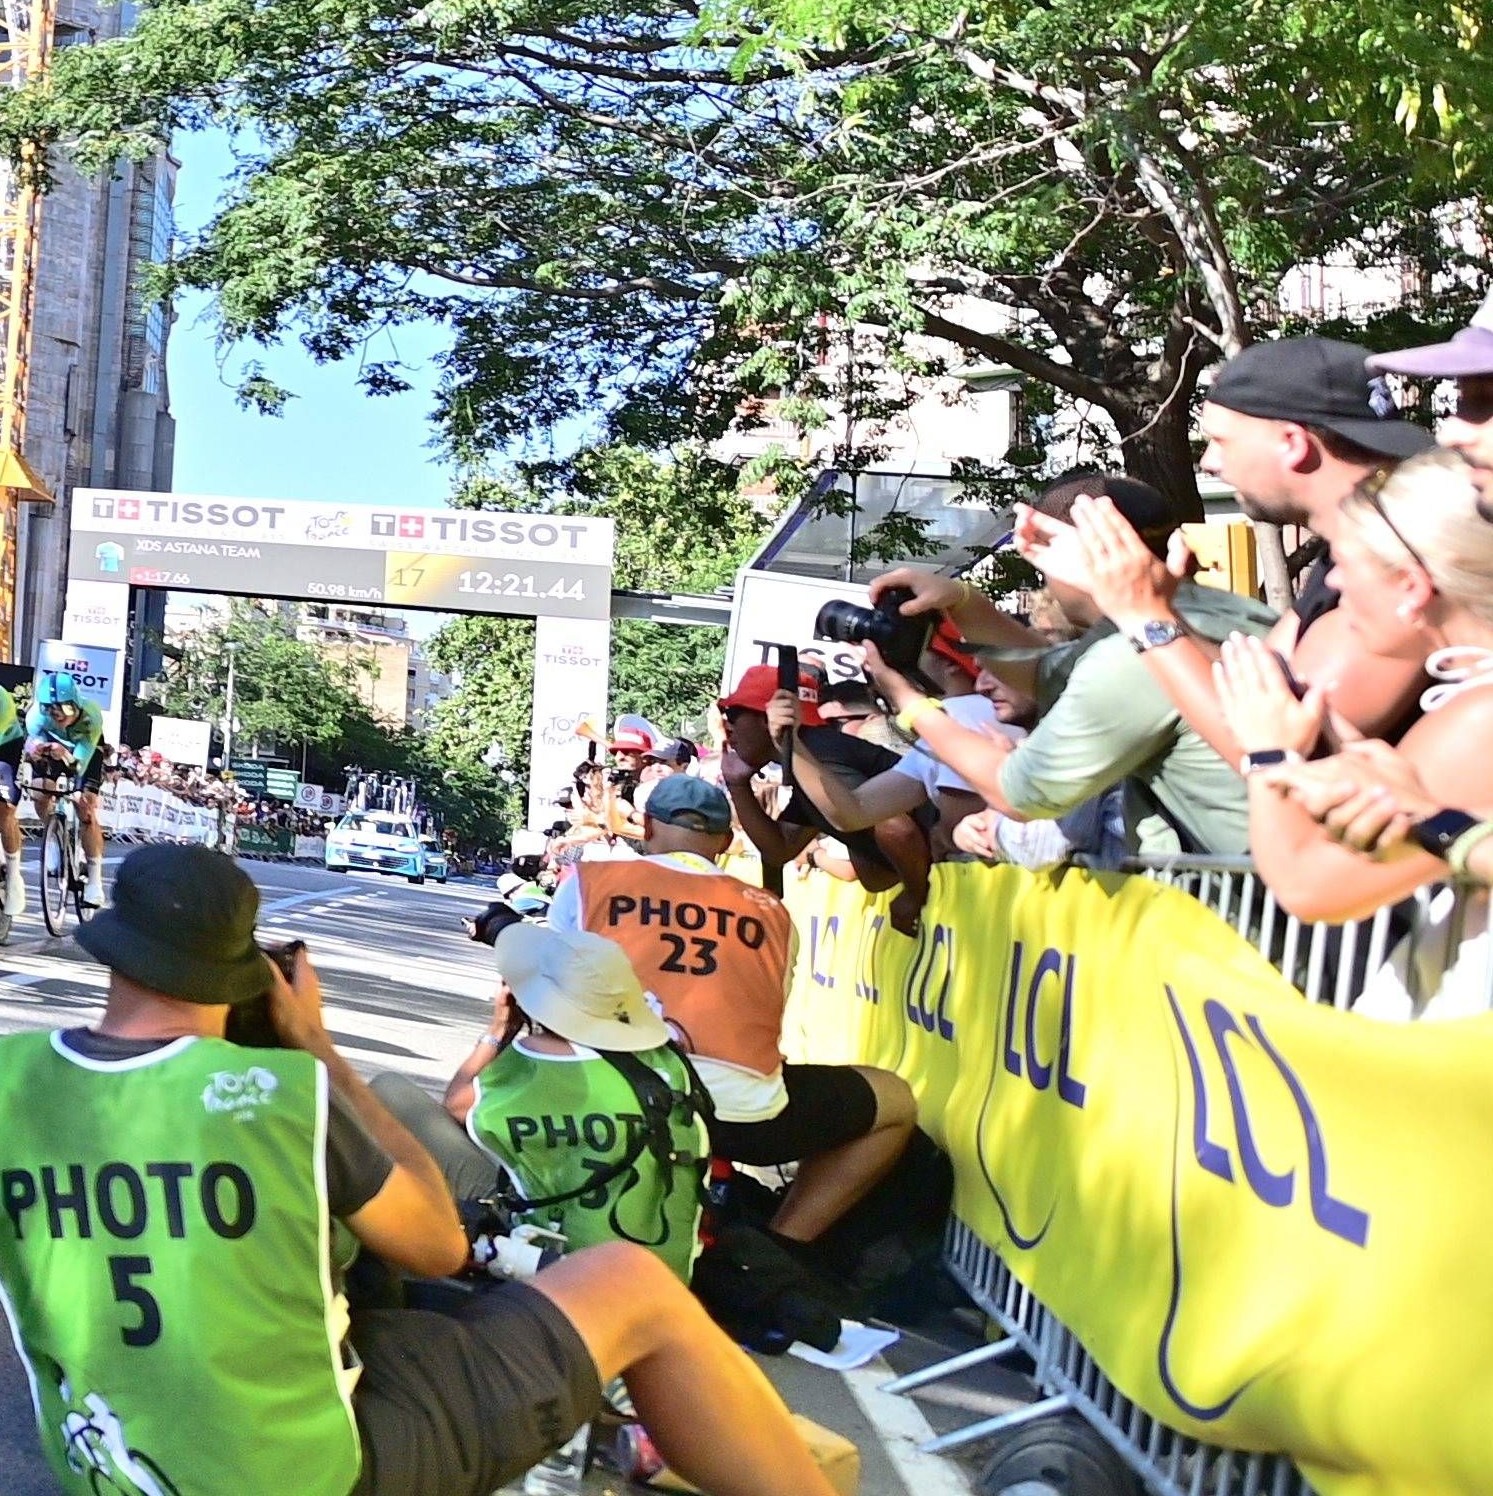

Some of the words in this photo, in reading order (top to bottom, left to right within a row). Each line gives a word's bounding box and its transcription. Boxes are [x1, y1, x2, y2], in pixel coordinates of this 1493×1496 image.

[146, 501, 285, 529] TISSOT
[432, 517, 588, 549] TISSOT
[136, 539, 162, 553] XDS
[163, 542, 219, 557] ASTANA
[220, 545, 261, 560] TEAM
[307, 582, 346, 597] 50.98
[348, 585, 383, 600] km/h
[393, 568, 425, 588] 17
[458, 571, 586, 602] 12:21.44
[72, 614, 121, 626] TISSOT
[543, 654, 602, 668] TISSOT
[42, 670, 109, 689] SOT
[608, 895, 765, 950] PHOTO
[659, 932, 718, 976] 23
[907, 923, 953, 1042] LCL
[1004, 941, 1086, 1109] LCL
[507, 1113, 645, 1154] PHOT
[1200, 997, 1370, 1250] LCL
[1, 1161, 257, 1242] PHOTO
[108, 1255, 163, 1347] 5
